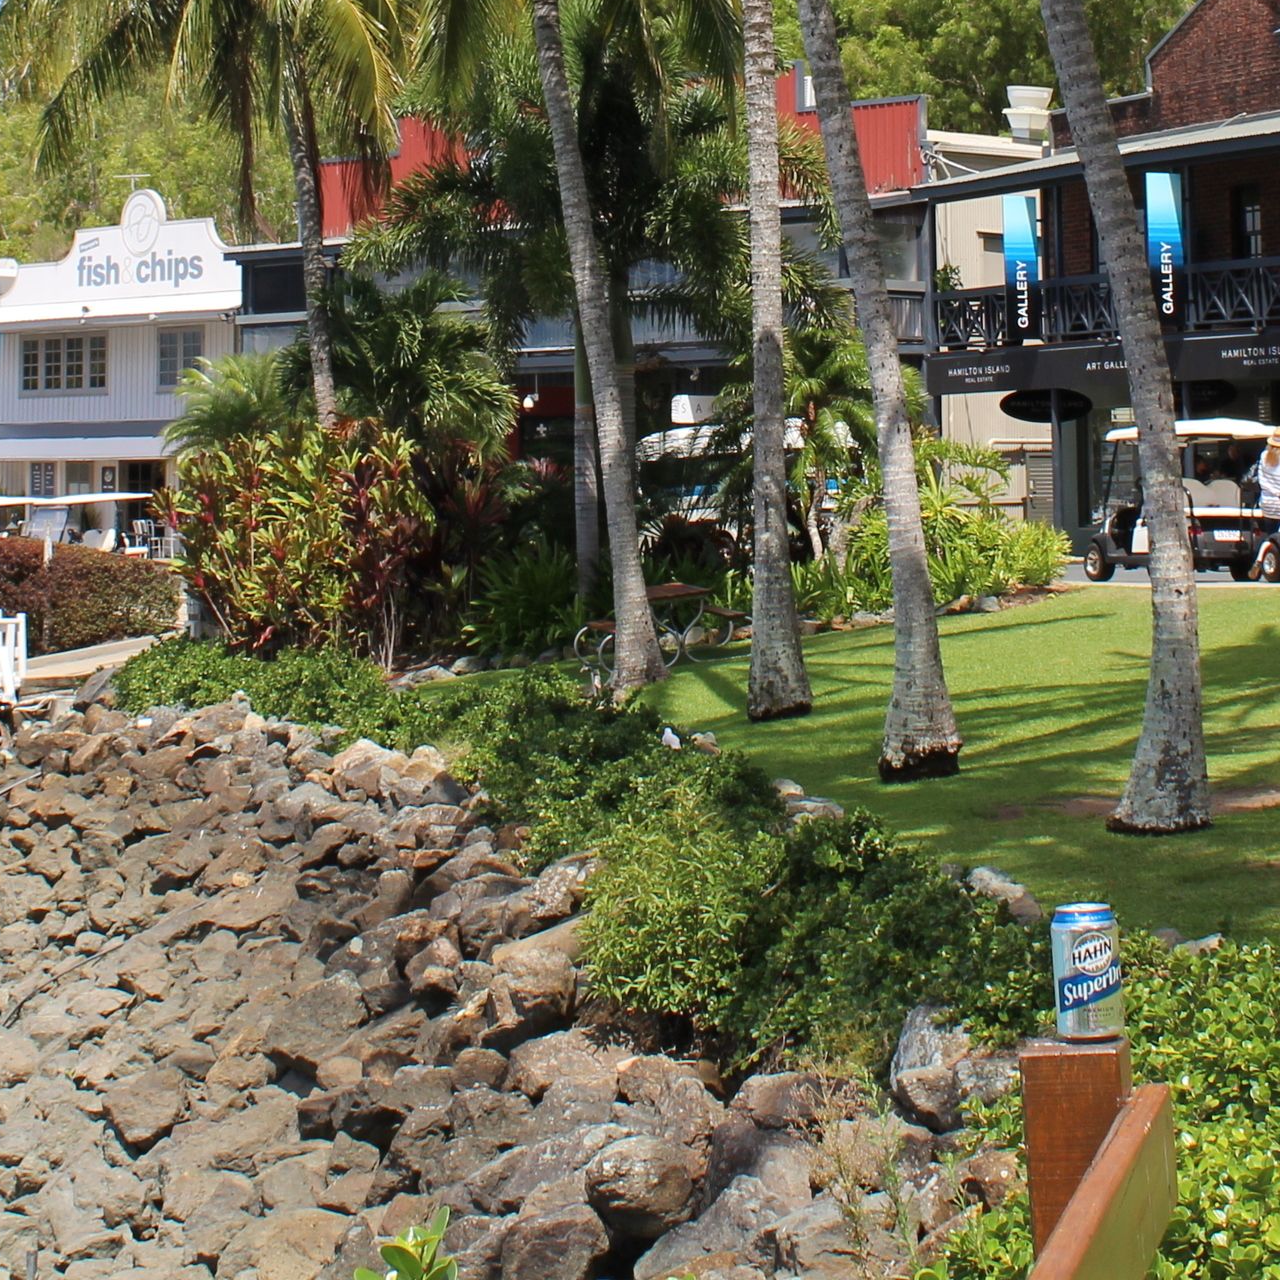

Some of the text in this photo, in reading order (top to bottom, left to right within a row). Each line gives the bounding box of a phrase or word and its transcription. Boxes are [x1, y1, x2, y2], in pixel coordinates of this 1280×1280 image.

[77, 255, 120, 287] fish
[136, 249, 203, 288] chips
[1160, 241, 1174, 314] GALLERY
[1016, 260, 1029, 328] GALLERY
[1086, 361, 1101, 371] ART
[1221, 346, 1265, 359] HAMILTON
[948, 364, 1010, 377] HAMILTON ISLAND
[1072, 938, 1112, 966] HAHN
[1063, 965, 1122, 1006] SuperDr
